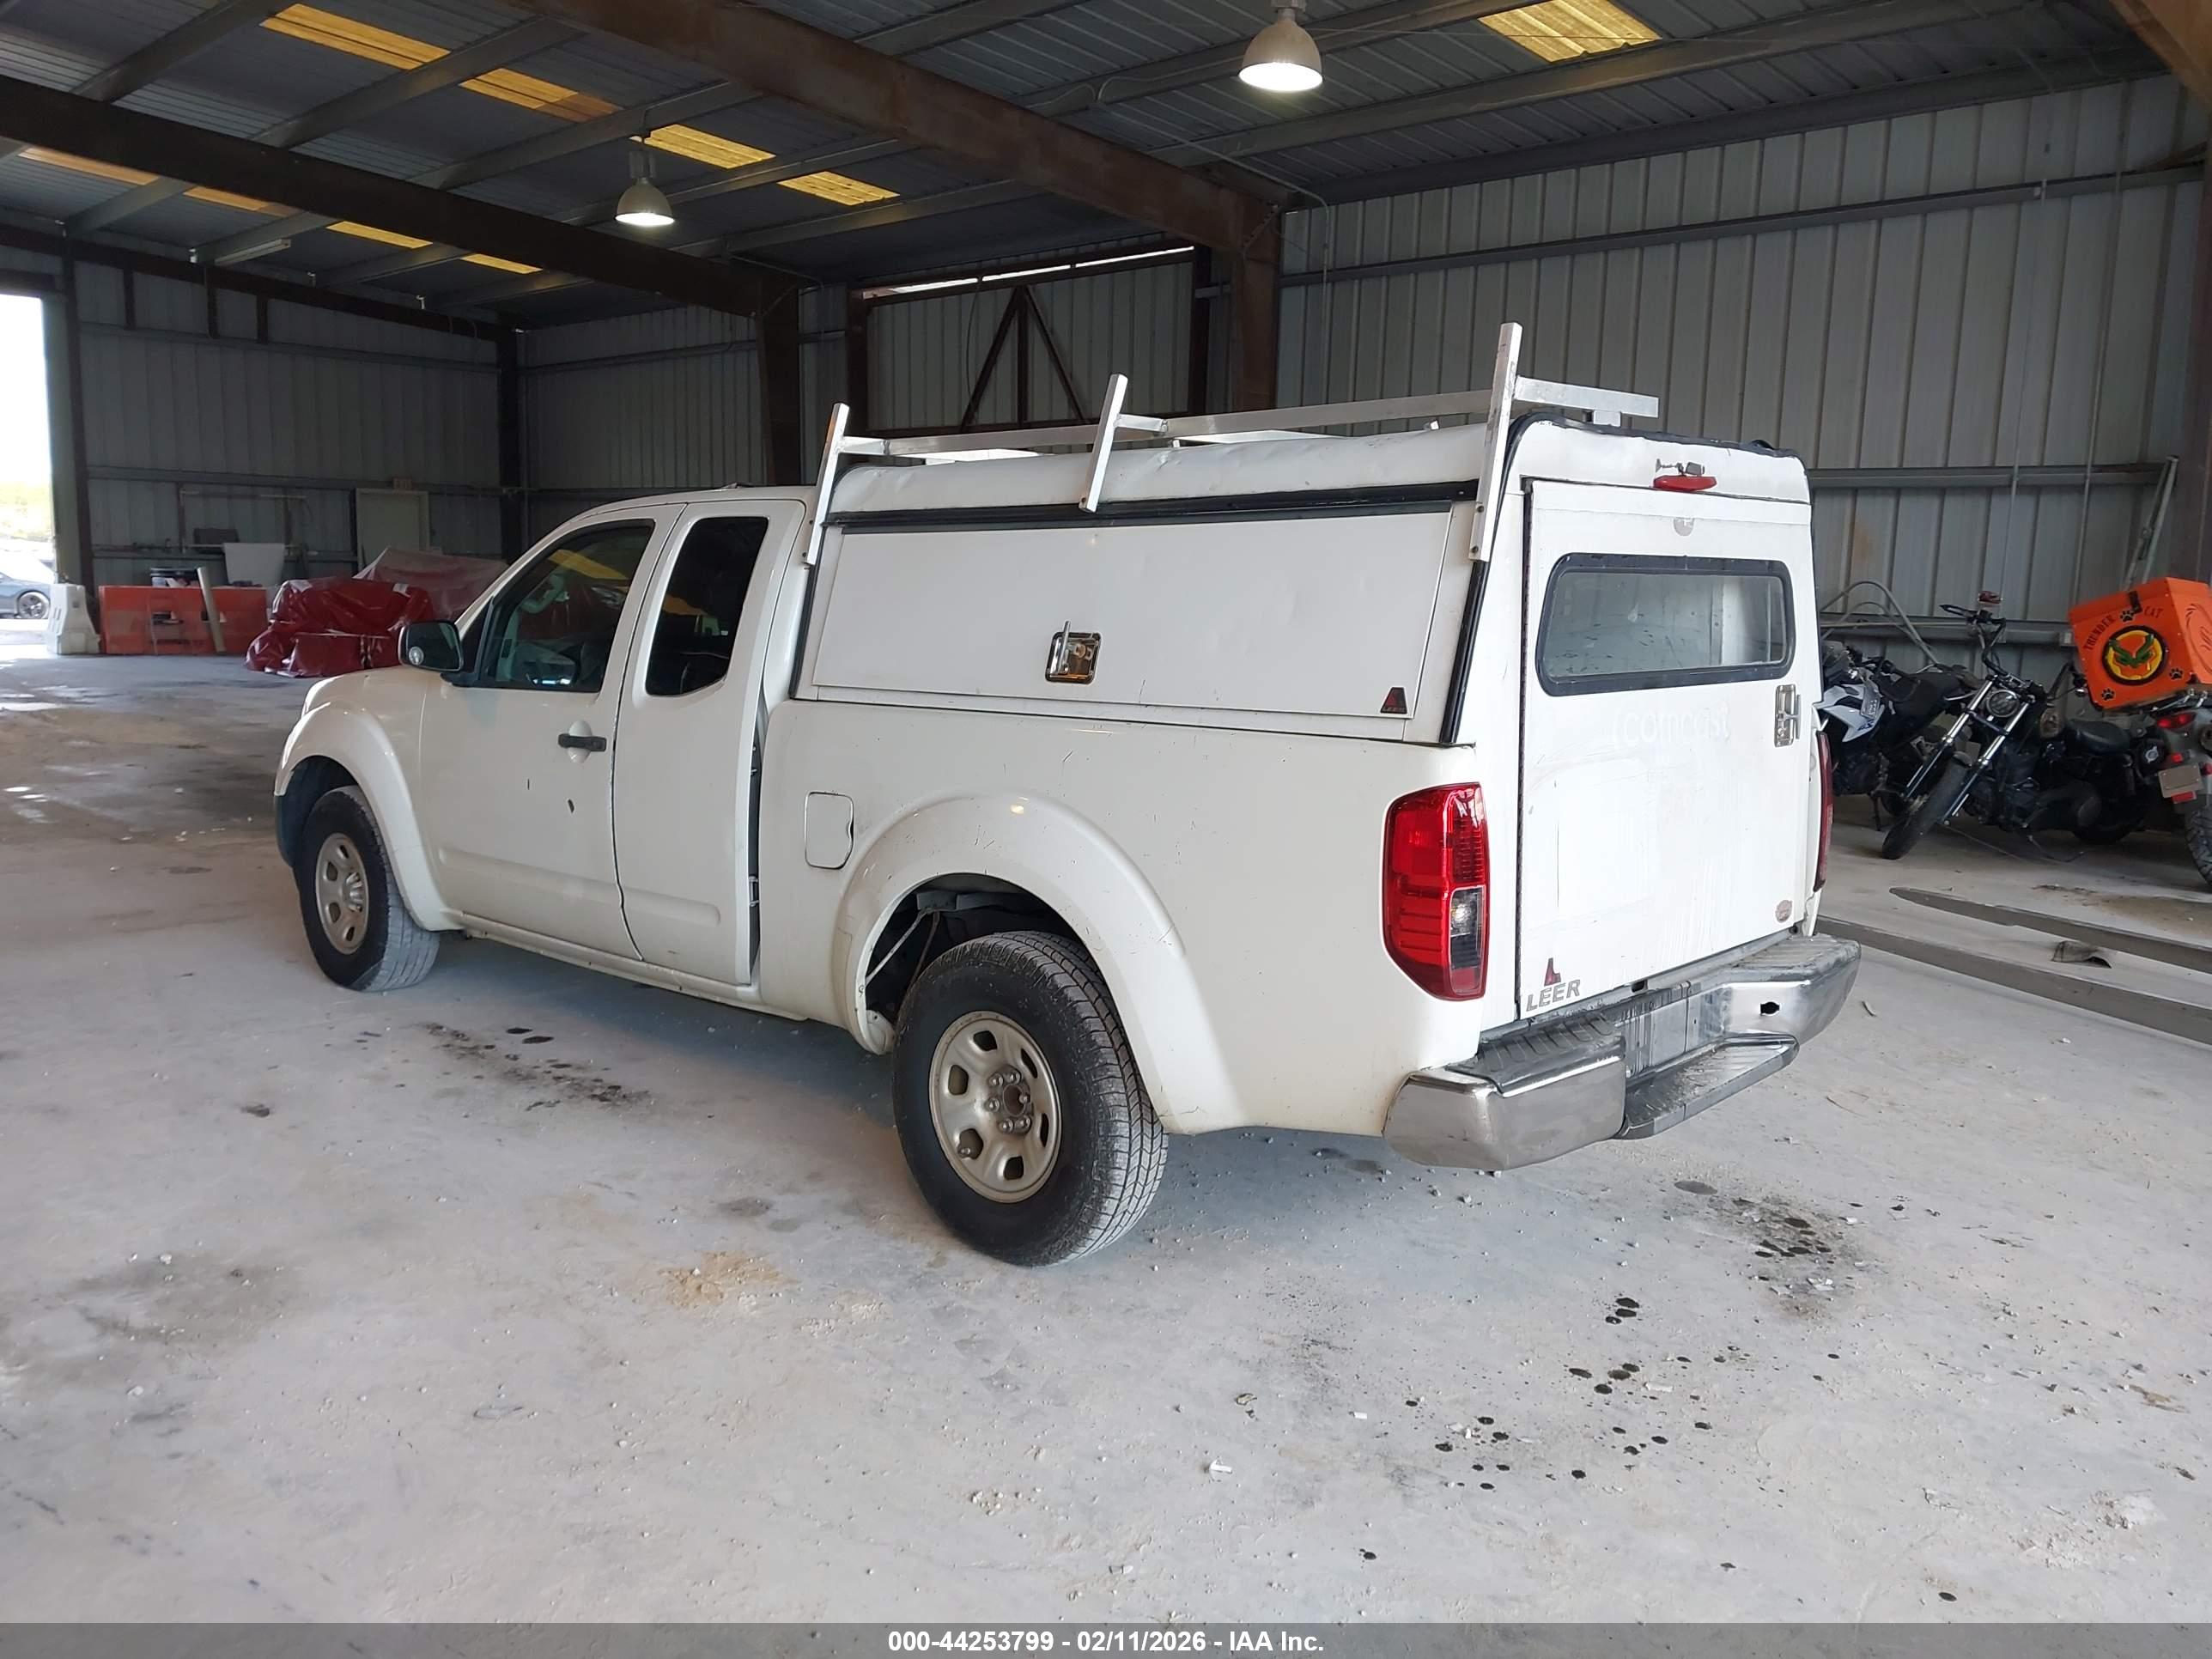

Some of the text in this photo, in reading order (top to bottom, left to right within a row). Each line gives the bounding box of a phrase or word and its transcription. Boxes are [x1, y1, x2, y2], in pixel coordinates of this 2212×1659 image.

[2082, 605, 2164, 651] THUNDER CAT
[1526, 979, 1581, 1012] LEER
